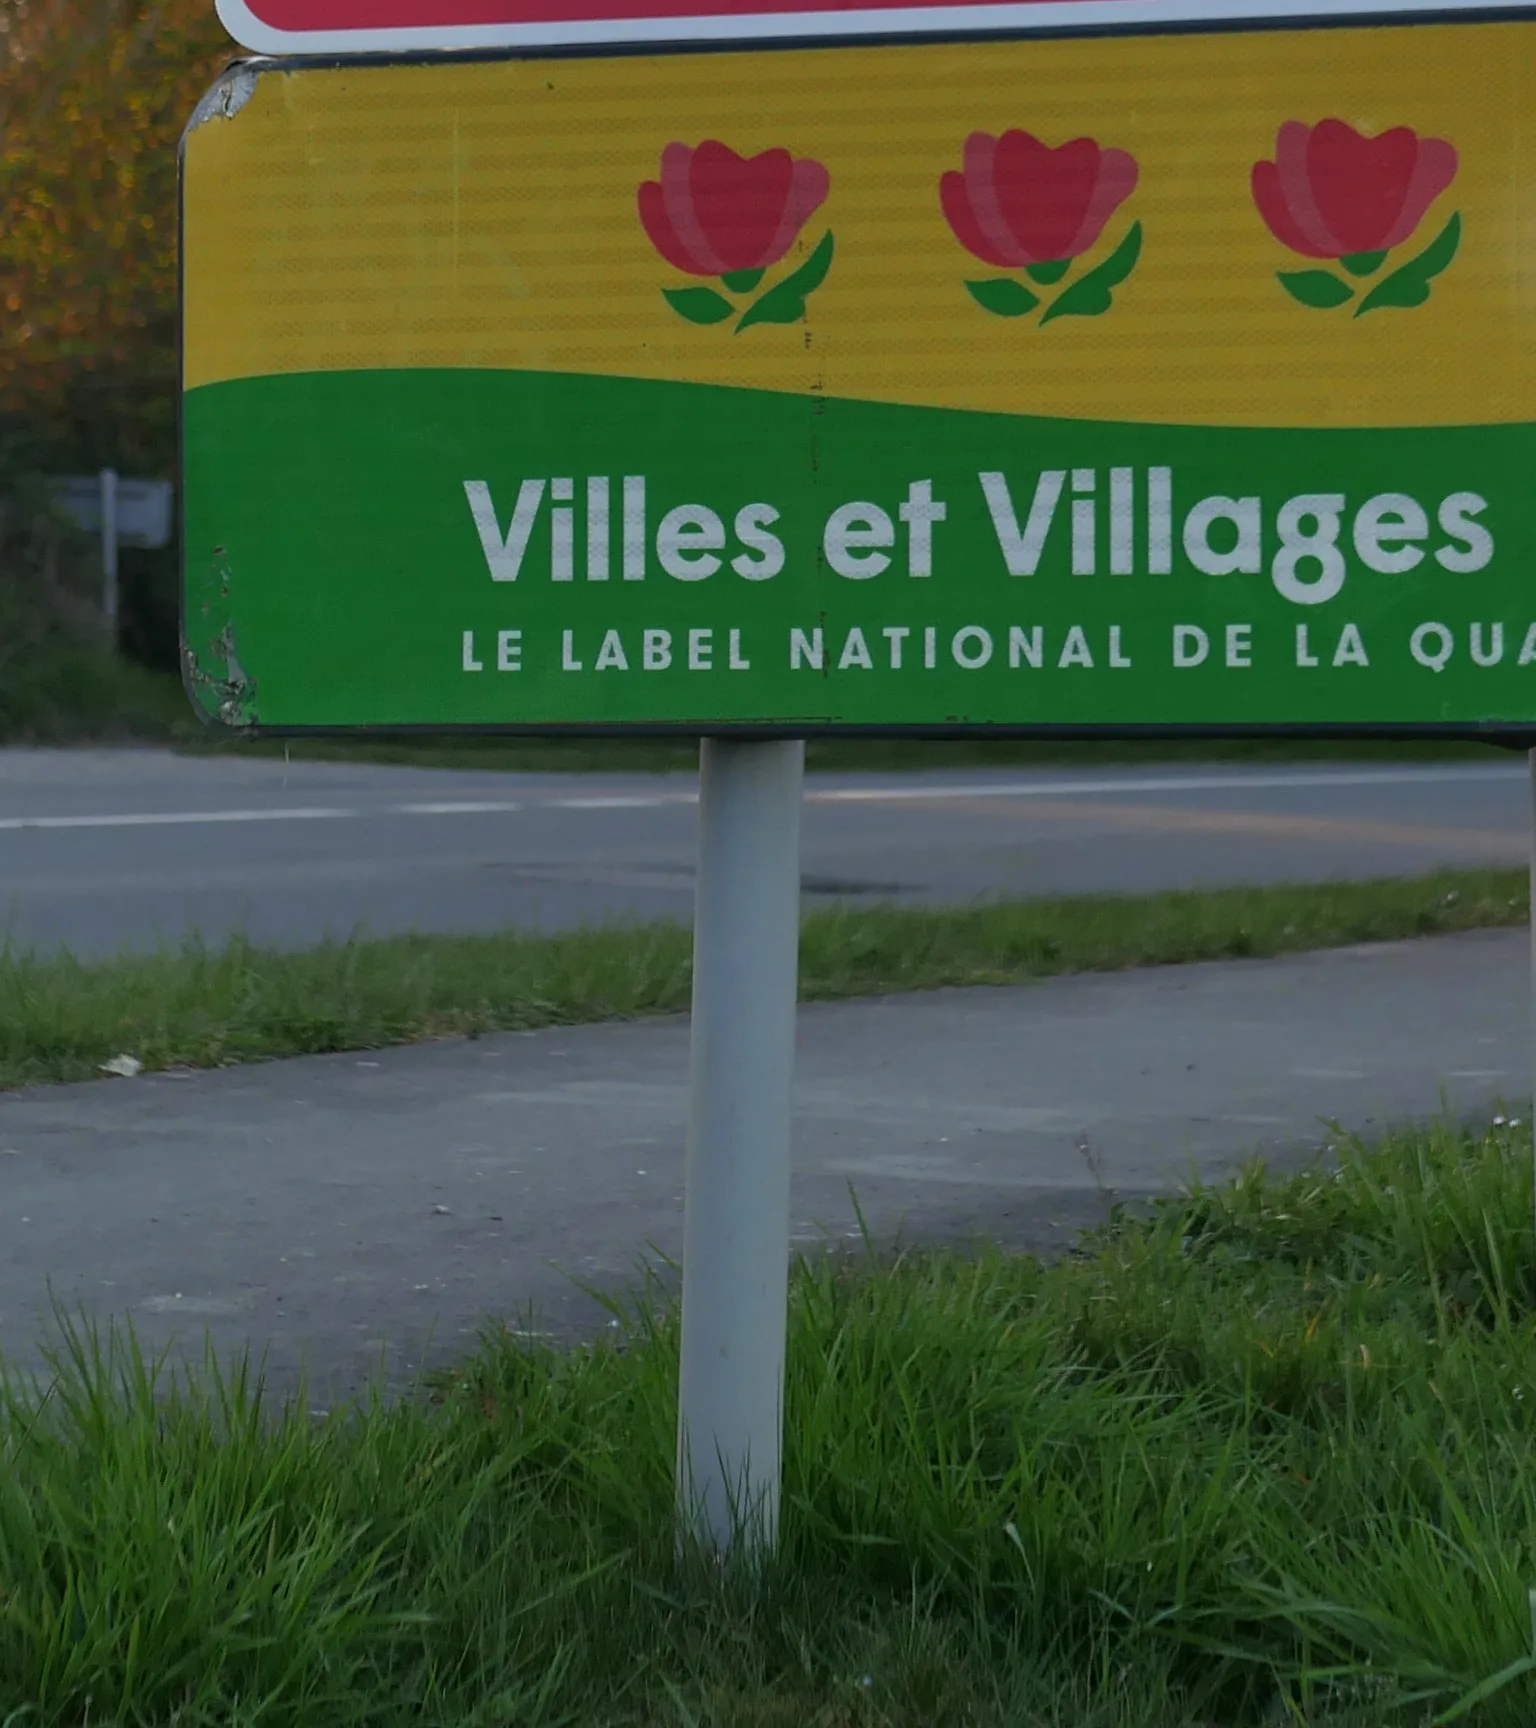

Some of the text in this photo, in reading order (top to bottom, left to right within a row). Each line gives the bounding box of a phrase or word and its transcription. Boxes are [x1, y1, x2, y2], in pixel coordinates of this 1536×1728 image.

[463, 475, 786, 581] Villes
[824, 478, 947, 580] et
[978, 466, 1494, 605] Villages
[463, 629, 522, 672] LE
[562, 628, 751, 671] LABEL
[790, 625, 1132, 670] NATIONAL
[1172, 623, 1252, 668] DE
[1295, 622, 1370, 667] LA
